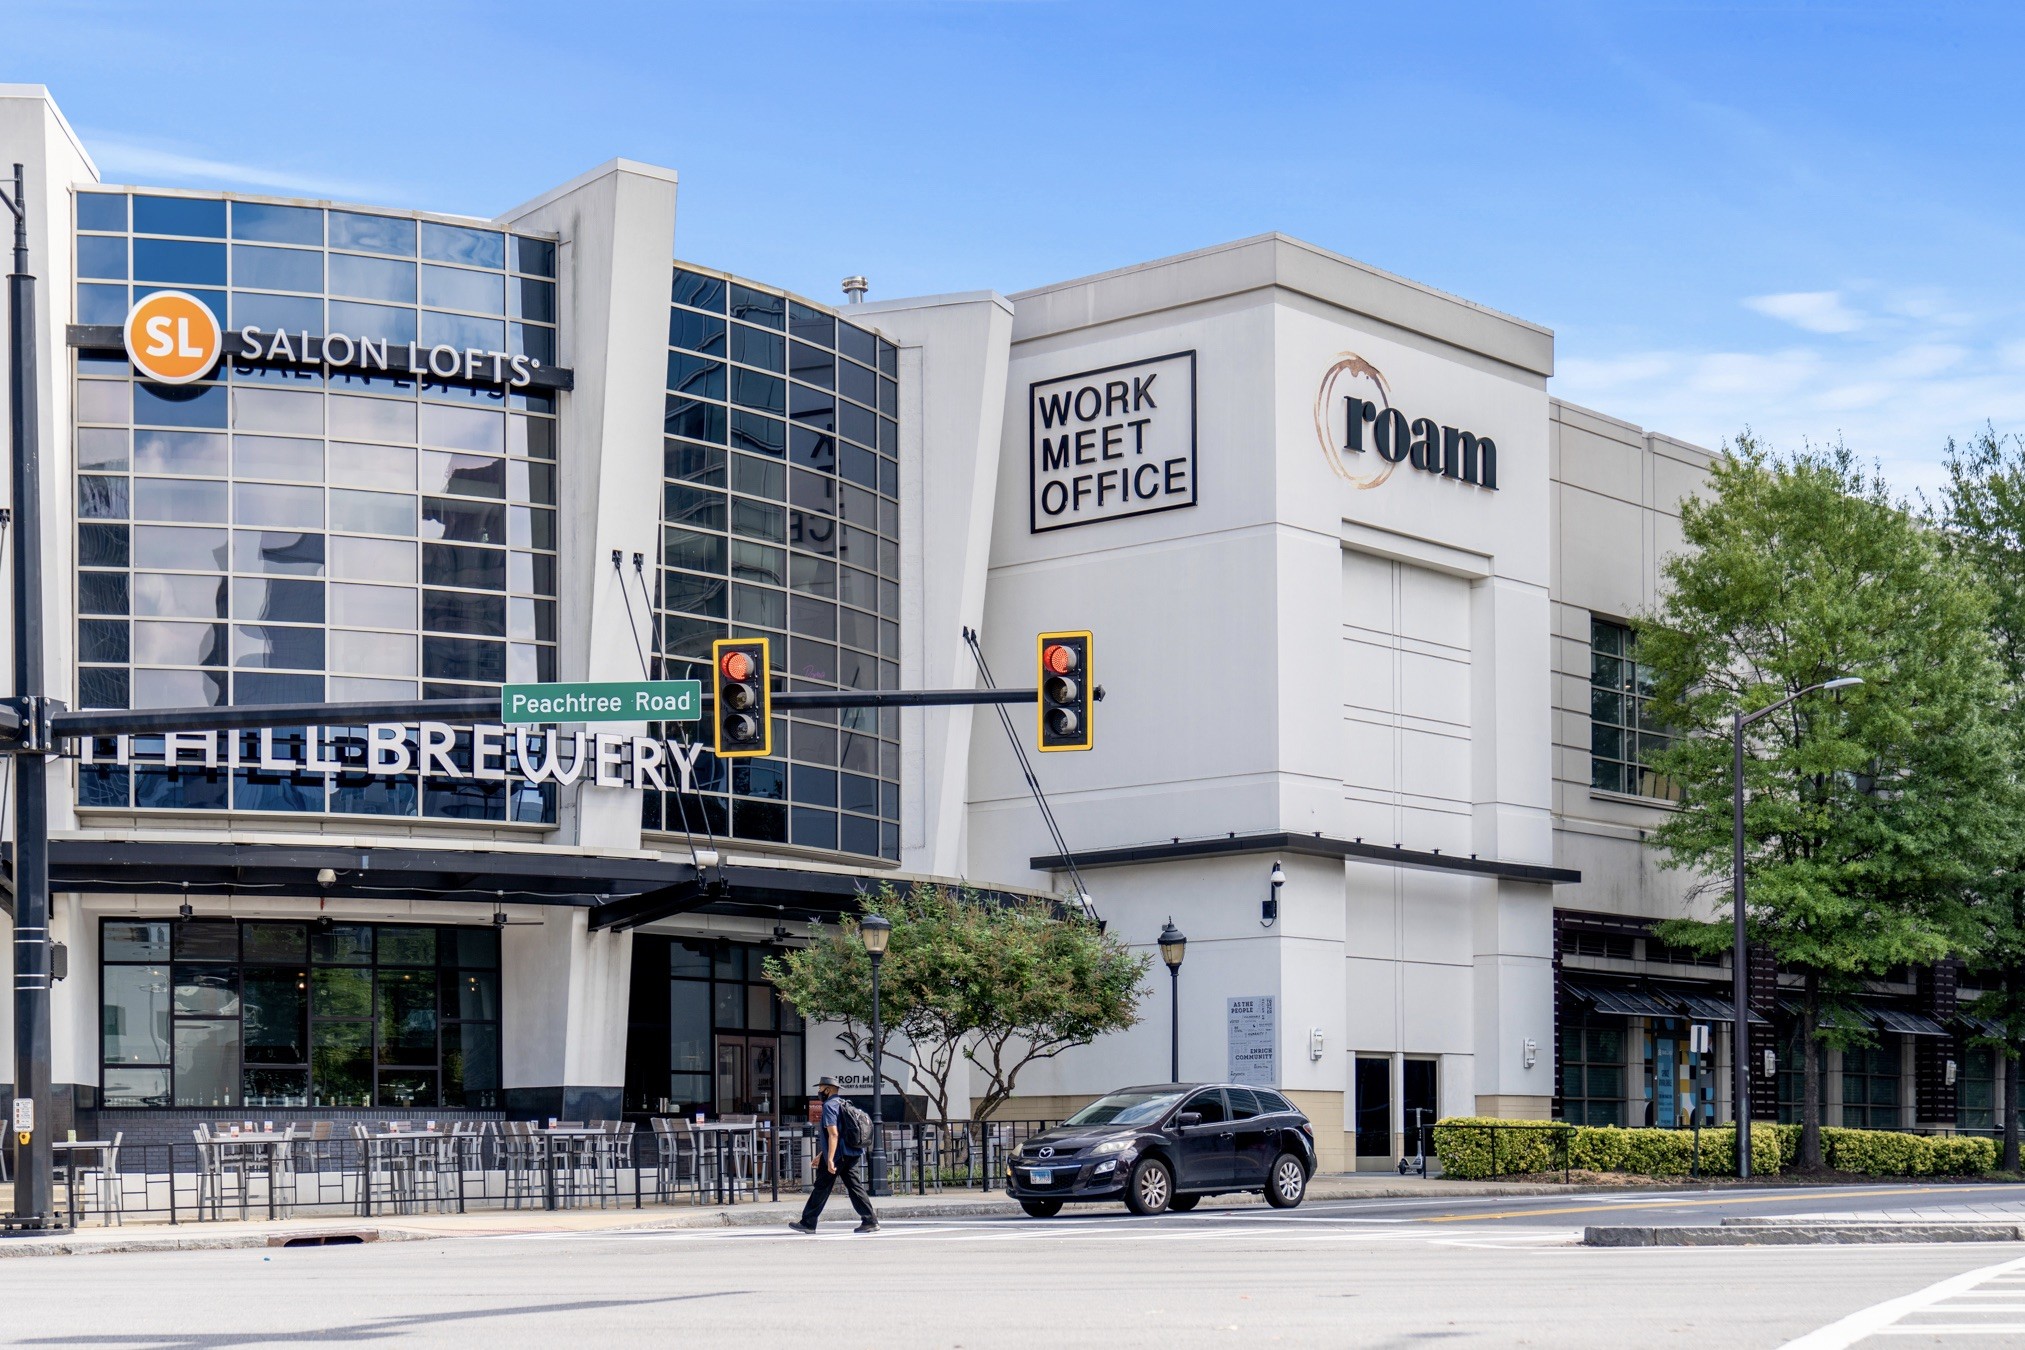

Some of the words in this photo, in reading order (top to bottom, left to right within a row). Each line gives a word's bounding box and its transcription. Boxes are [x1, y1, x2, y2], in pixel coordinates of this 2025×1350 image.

[145, 315, 204, 359] SL
[240, 325, 388, 371] SALON
[1038, 373, 1158, 429] WORK
[1042, 418, 1152, 472] MEET
[1343, 395, 1499, 491] roam
[1041, 457, 1188, 515] OFFICE
[512, 694, 622, 714] Peachtree
[635, 691, 690, 711] Road
[367, 721, 704, 794] BREWERY
[836, 1076, 860, 1084] RON
[862, 1076, 886, 1084] HIL
